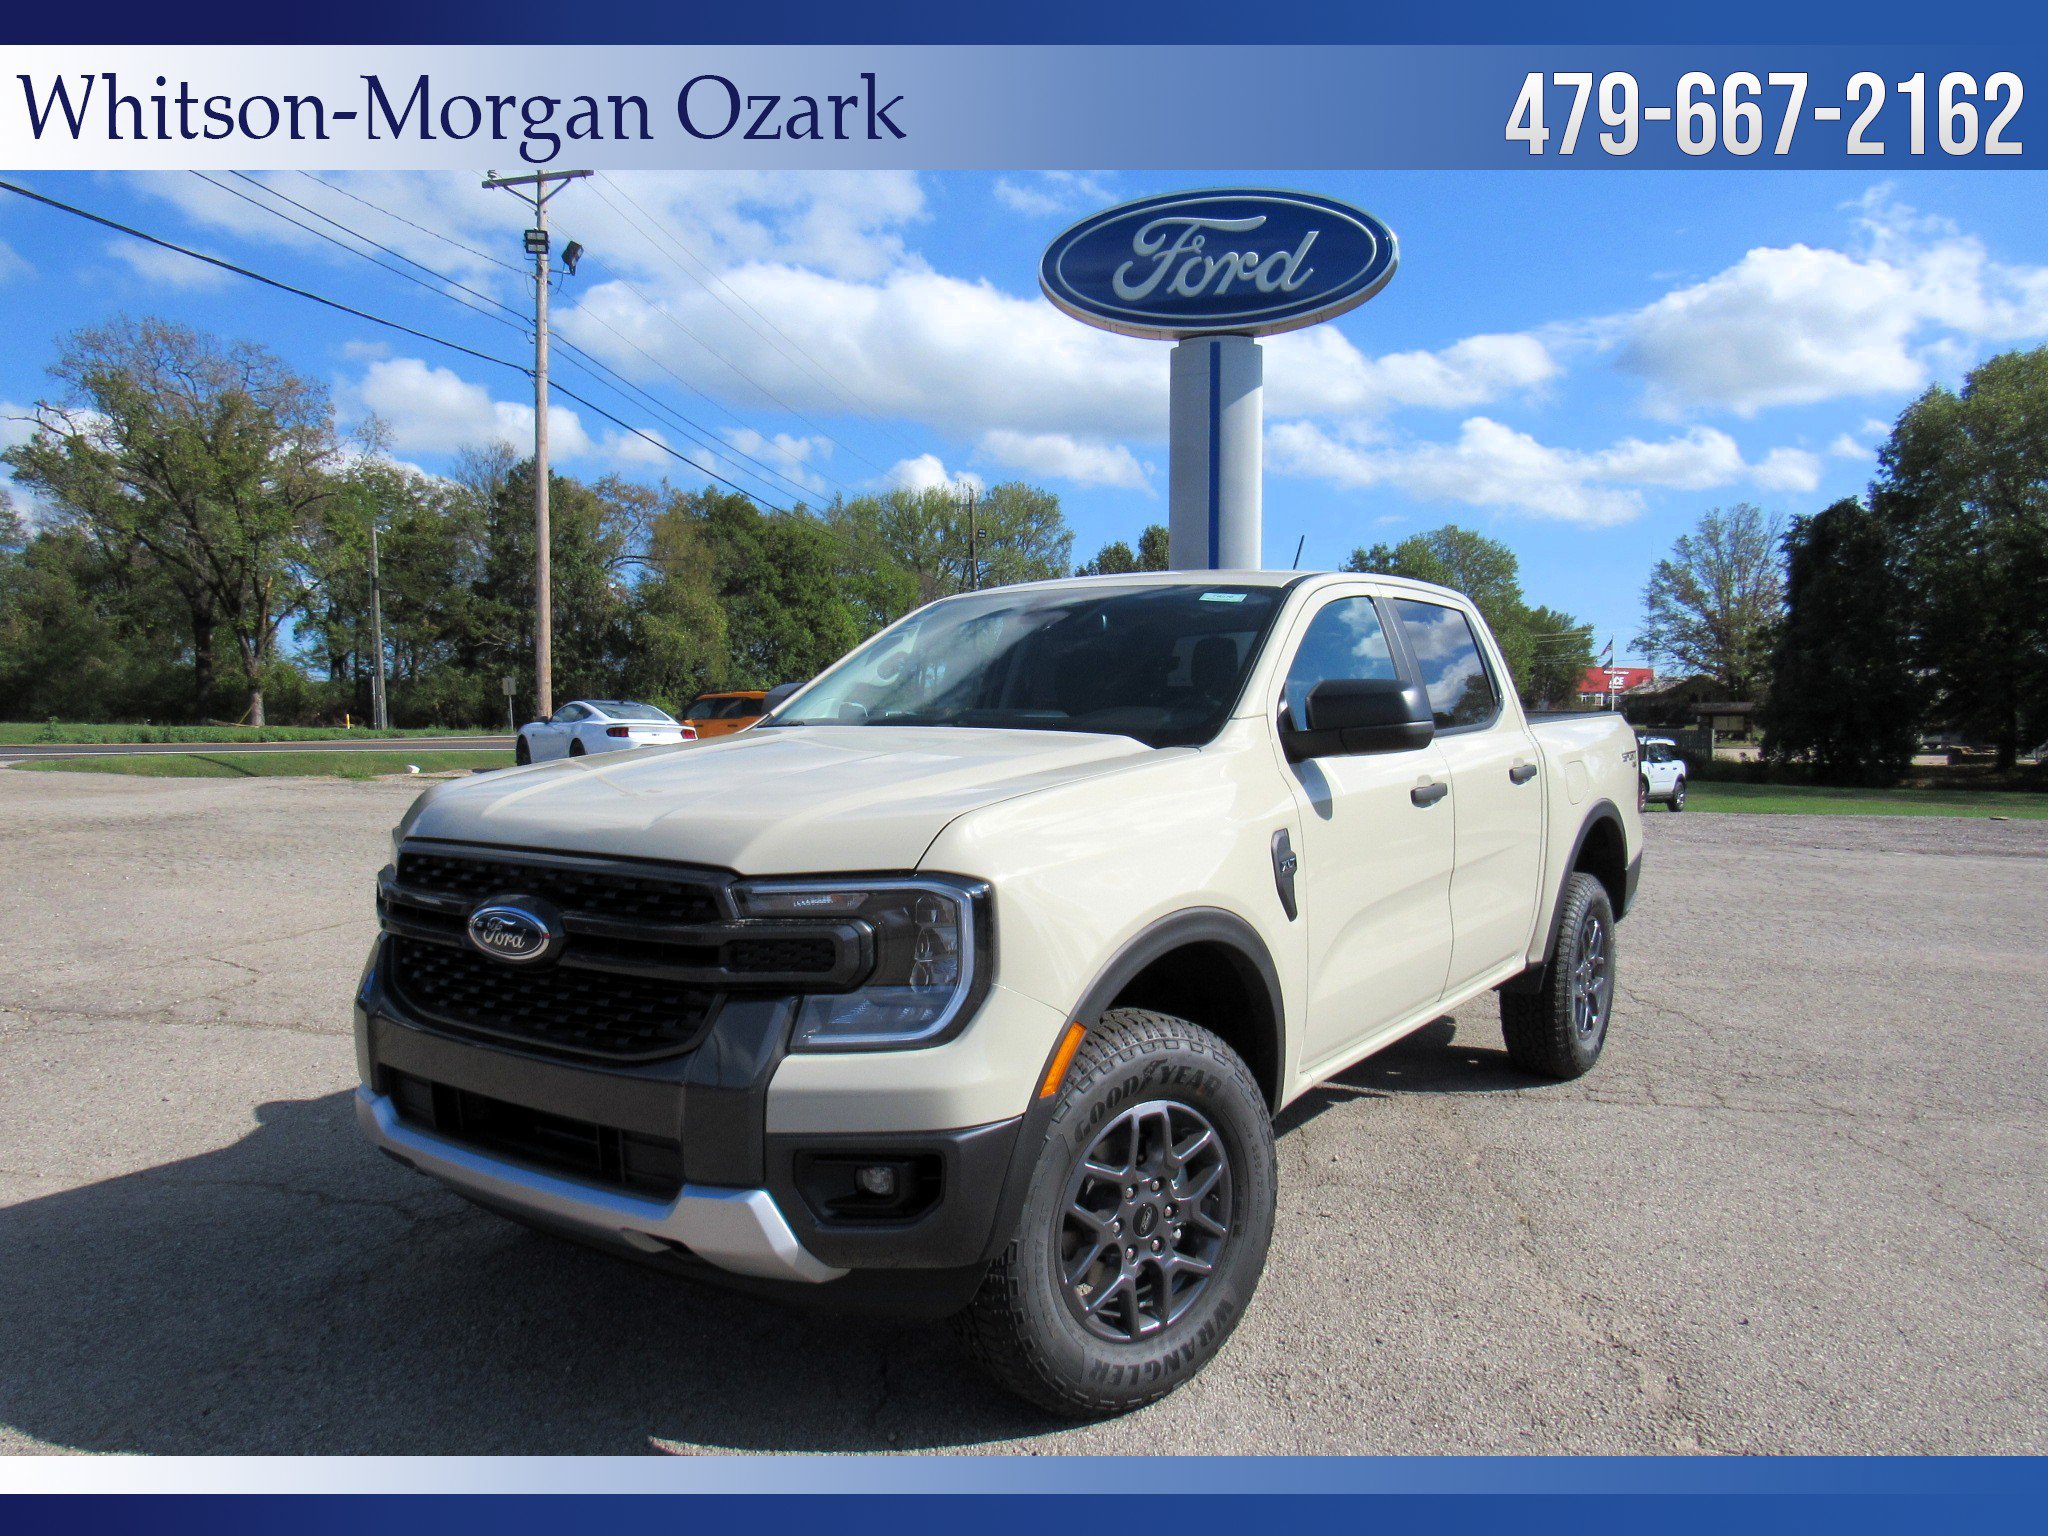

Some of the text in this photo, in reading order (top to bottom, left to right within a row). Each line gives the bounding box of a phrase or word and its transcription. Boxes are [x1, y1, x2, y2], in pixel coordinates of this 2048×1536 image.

[1112, 215, 1319, 301] Ford
[482, 916, 527, 949] Ford
[1074, 1060, 1222, 1143] GOODYEAR
[1088, 1299, 1235, 1387] WRANGLER
